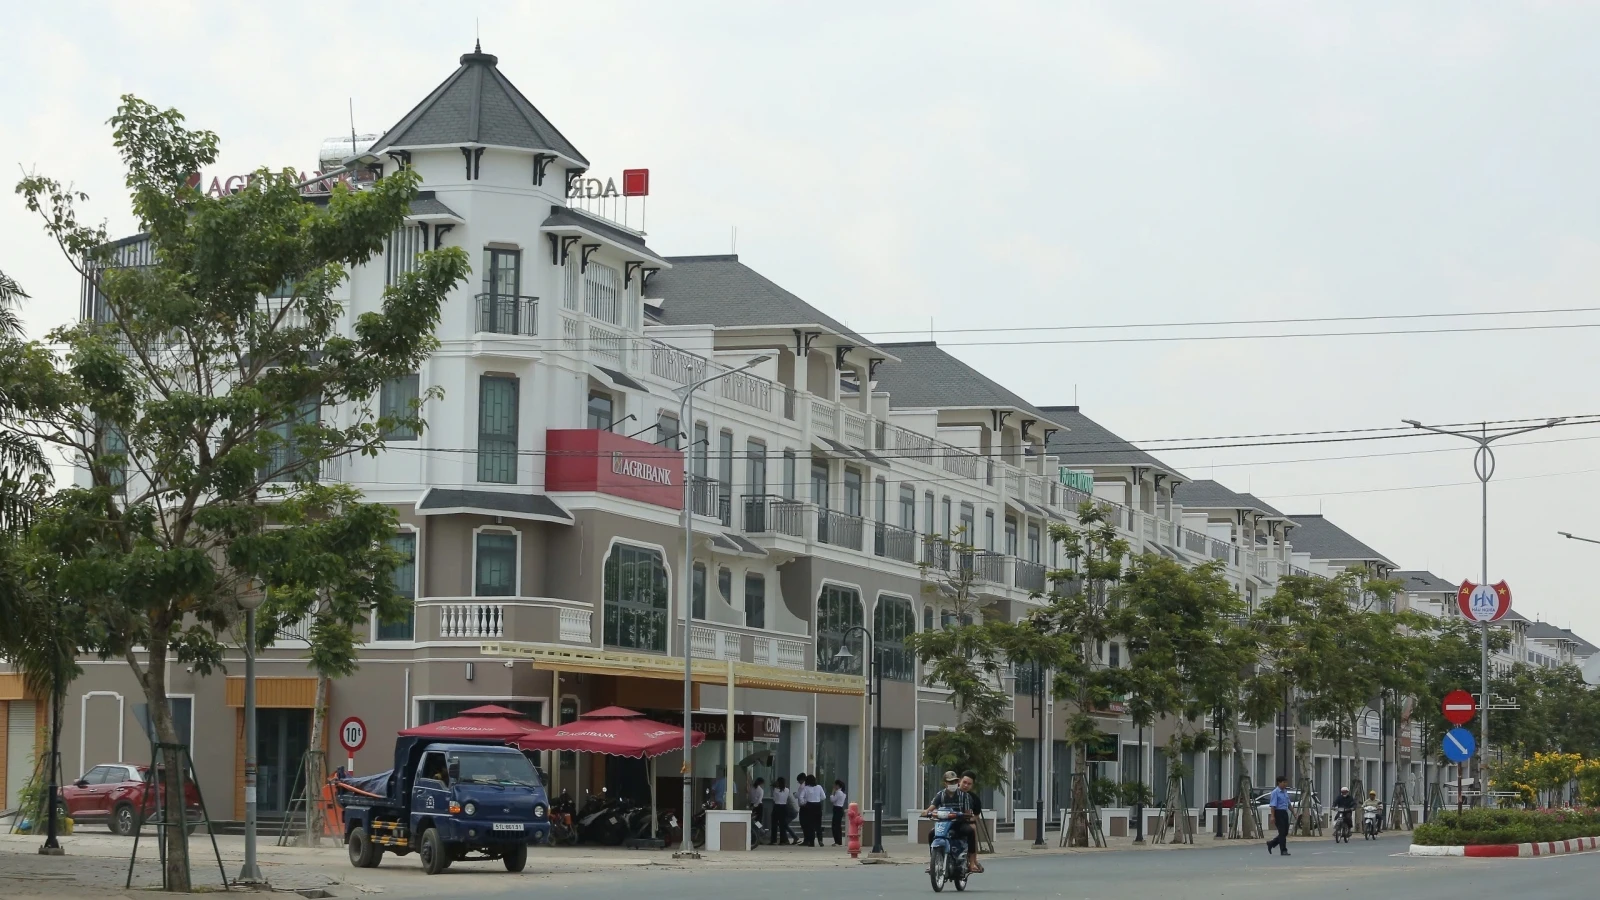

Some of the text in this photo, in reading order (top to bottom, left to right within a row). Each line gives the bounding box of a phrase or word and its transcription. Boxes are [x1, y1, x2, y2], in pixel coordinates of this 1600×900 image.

[623, 459, 672, 486] AGRIBANK
[766, 718, 781, 733] CDM
[568, 731, 617, 740] AGRIBANK
